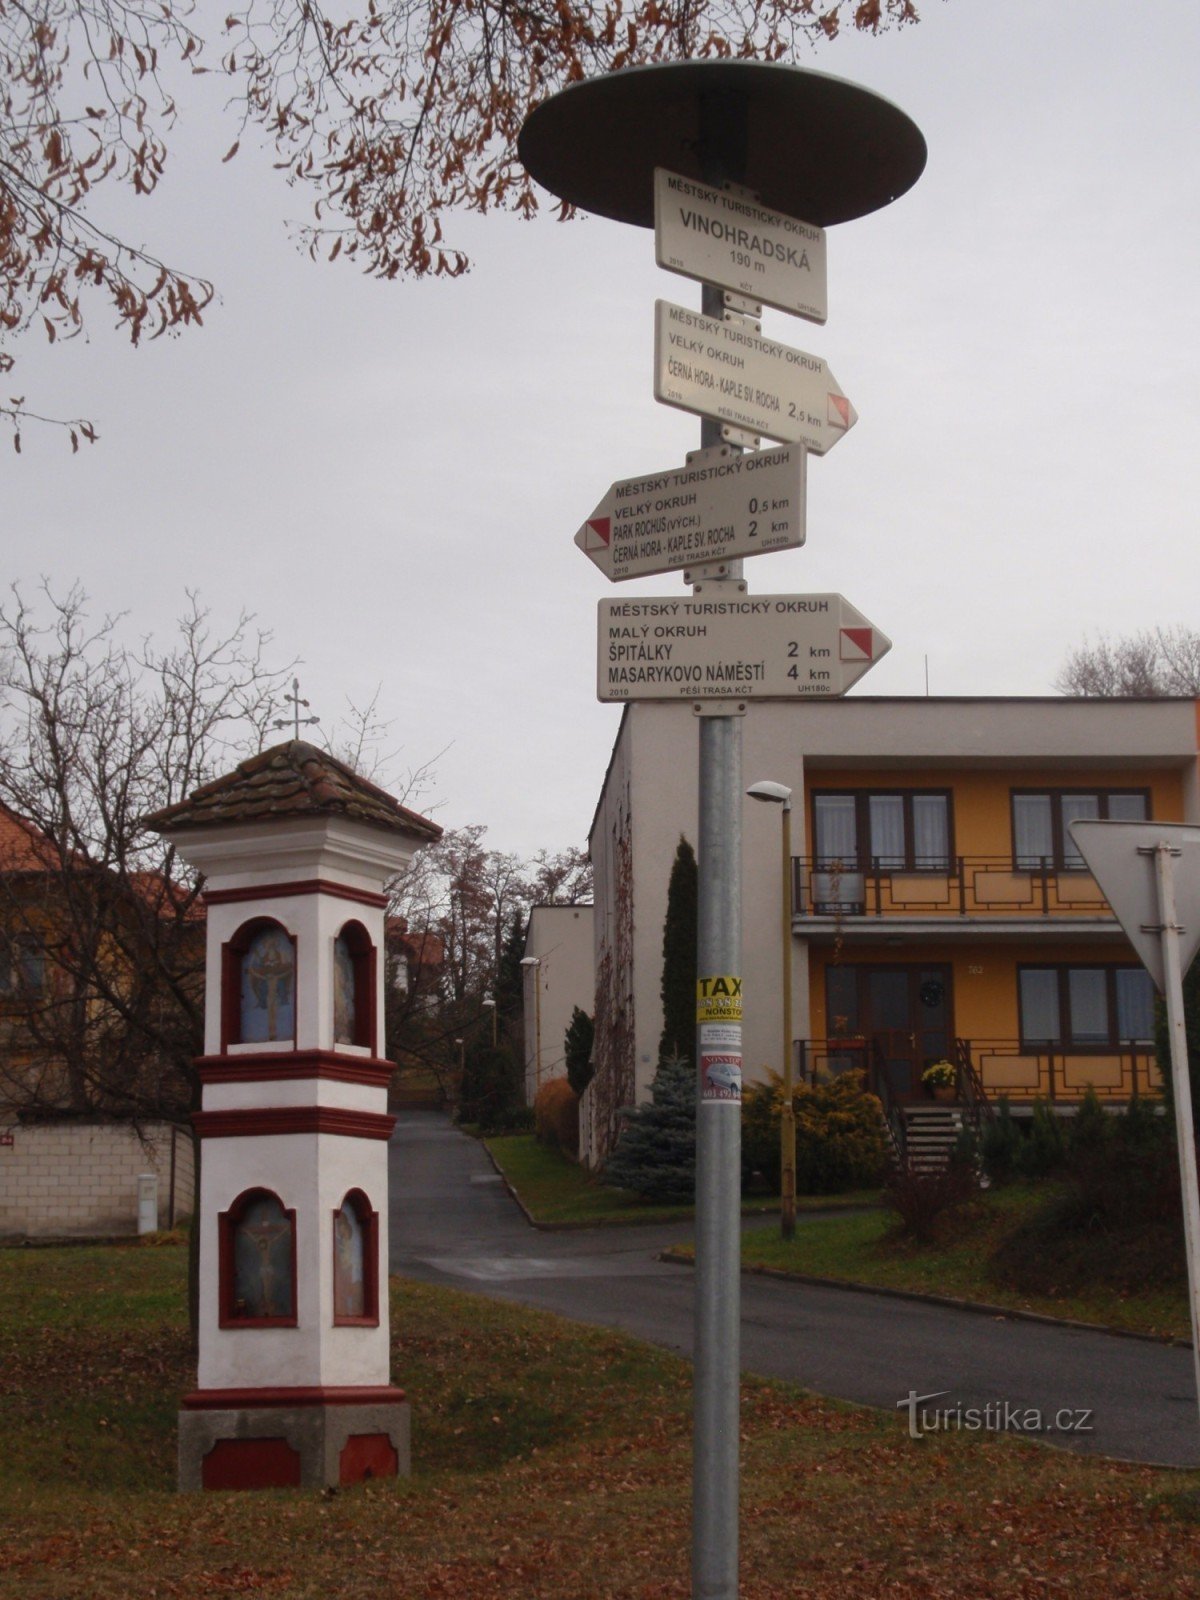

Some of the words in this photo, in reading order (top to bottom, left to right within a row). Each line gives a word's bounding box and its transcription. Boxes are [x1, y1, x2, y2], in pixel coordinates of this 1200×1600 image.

[668, 177, 718, 205] MĚSTSKÝ
[722, 197, 781, 226] TURISTICKÝ
[784, 220, 820, 241] OKRUH
[680, 208, 810, 272] VINOHRADSKÁ
[730, 251, 750, 267] 190
[754, 262, 765, 273] m
[669, 307, 719, 335] MĚSTSKÝ
[723, 328, 783, 359] TURISTICKÝ
[786, 352, 822, 373] OKRUH
[669, 333, 704, 354] VELKÝ
[707, 348, 745, 369] OKRUH
[668, 356, 693, 382] ČERNÁ
[694, 368, 715, 389] HORA
[720, 377, 743, 399] KAPLE
[744, 388, 755, 404] SV.
[755, 392, 780, 412] ROCHA
[808, 414, 822, 427] km
[733, 411, 755, 425] TRASA
[616, 475, 670, 499] MĚSTSKÝ
[673, 457, 742, 486] TURISTICKÝ
[747, 452, 789, 472] OKRUH
[615, 499, 651, 519] VELKÝ
[656, 493, 697, 512] OKRUH
[613, 522, 634, 541] PARK
[635, 516, 666, 536] ROCHUS
[749, 498, 768, 514] 0,5
[772, 497, 789, 509] km
[613, 541, 638, 564] ČERNÁ
[640, 539, 661, 557] HORA
[667, 534, 692, 554] KAPLE
[694, 531, 706, 550] SV.
[707, 525, 735, 546] ROCHA
[748, 521, 758, 537] 2
[772, 519, 788, 533] km
[686, 549, 710, 562] TRASA
[610, 602, 679, 617] MĚSTSKÝ
[684, 600, 770, 615] TURISTICKÝ
[776, 601, 829, 613] OKRUH
[609, 624, 649, 639] MALÝ
[654, 625, 707, 638] OKRUH
[609, 641, 673, 662] ŠPITÁLKY
[788, 642, 799, 657] 2
[810, 647, 830, 658] km
[608, 665, 701, 683] MASARYKOVO
[706, 661, 765, 681] NÁMĚSTÍ
[787, 665, 799, 680] 4
[809, 669, 830, 680] km
[703, 686, 732, 694] TRASA
[734, 685, 753, 694] KČT
[798, 684, 831, 693] UH180c
